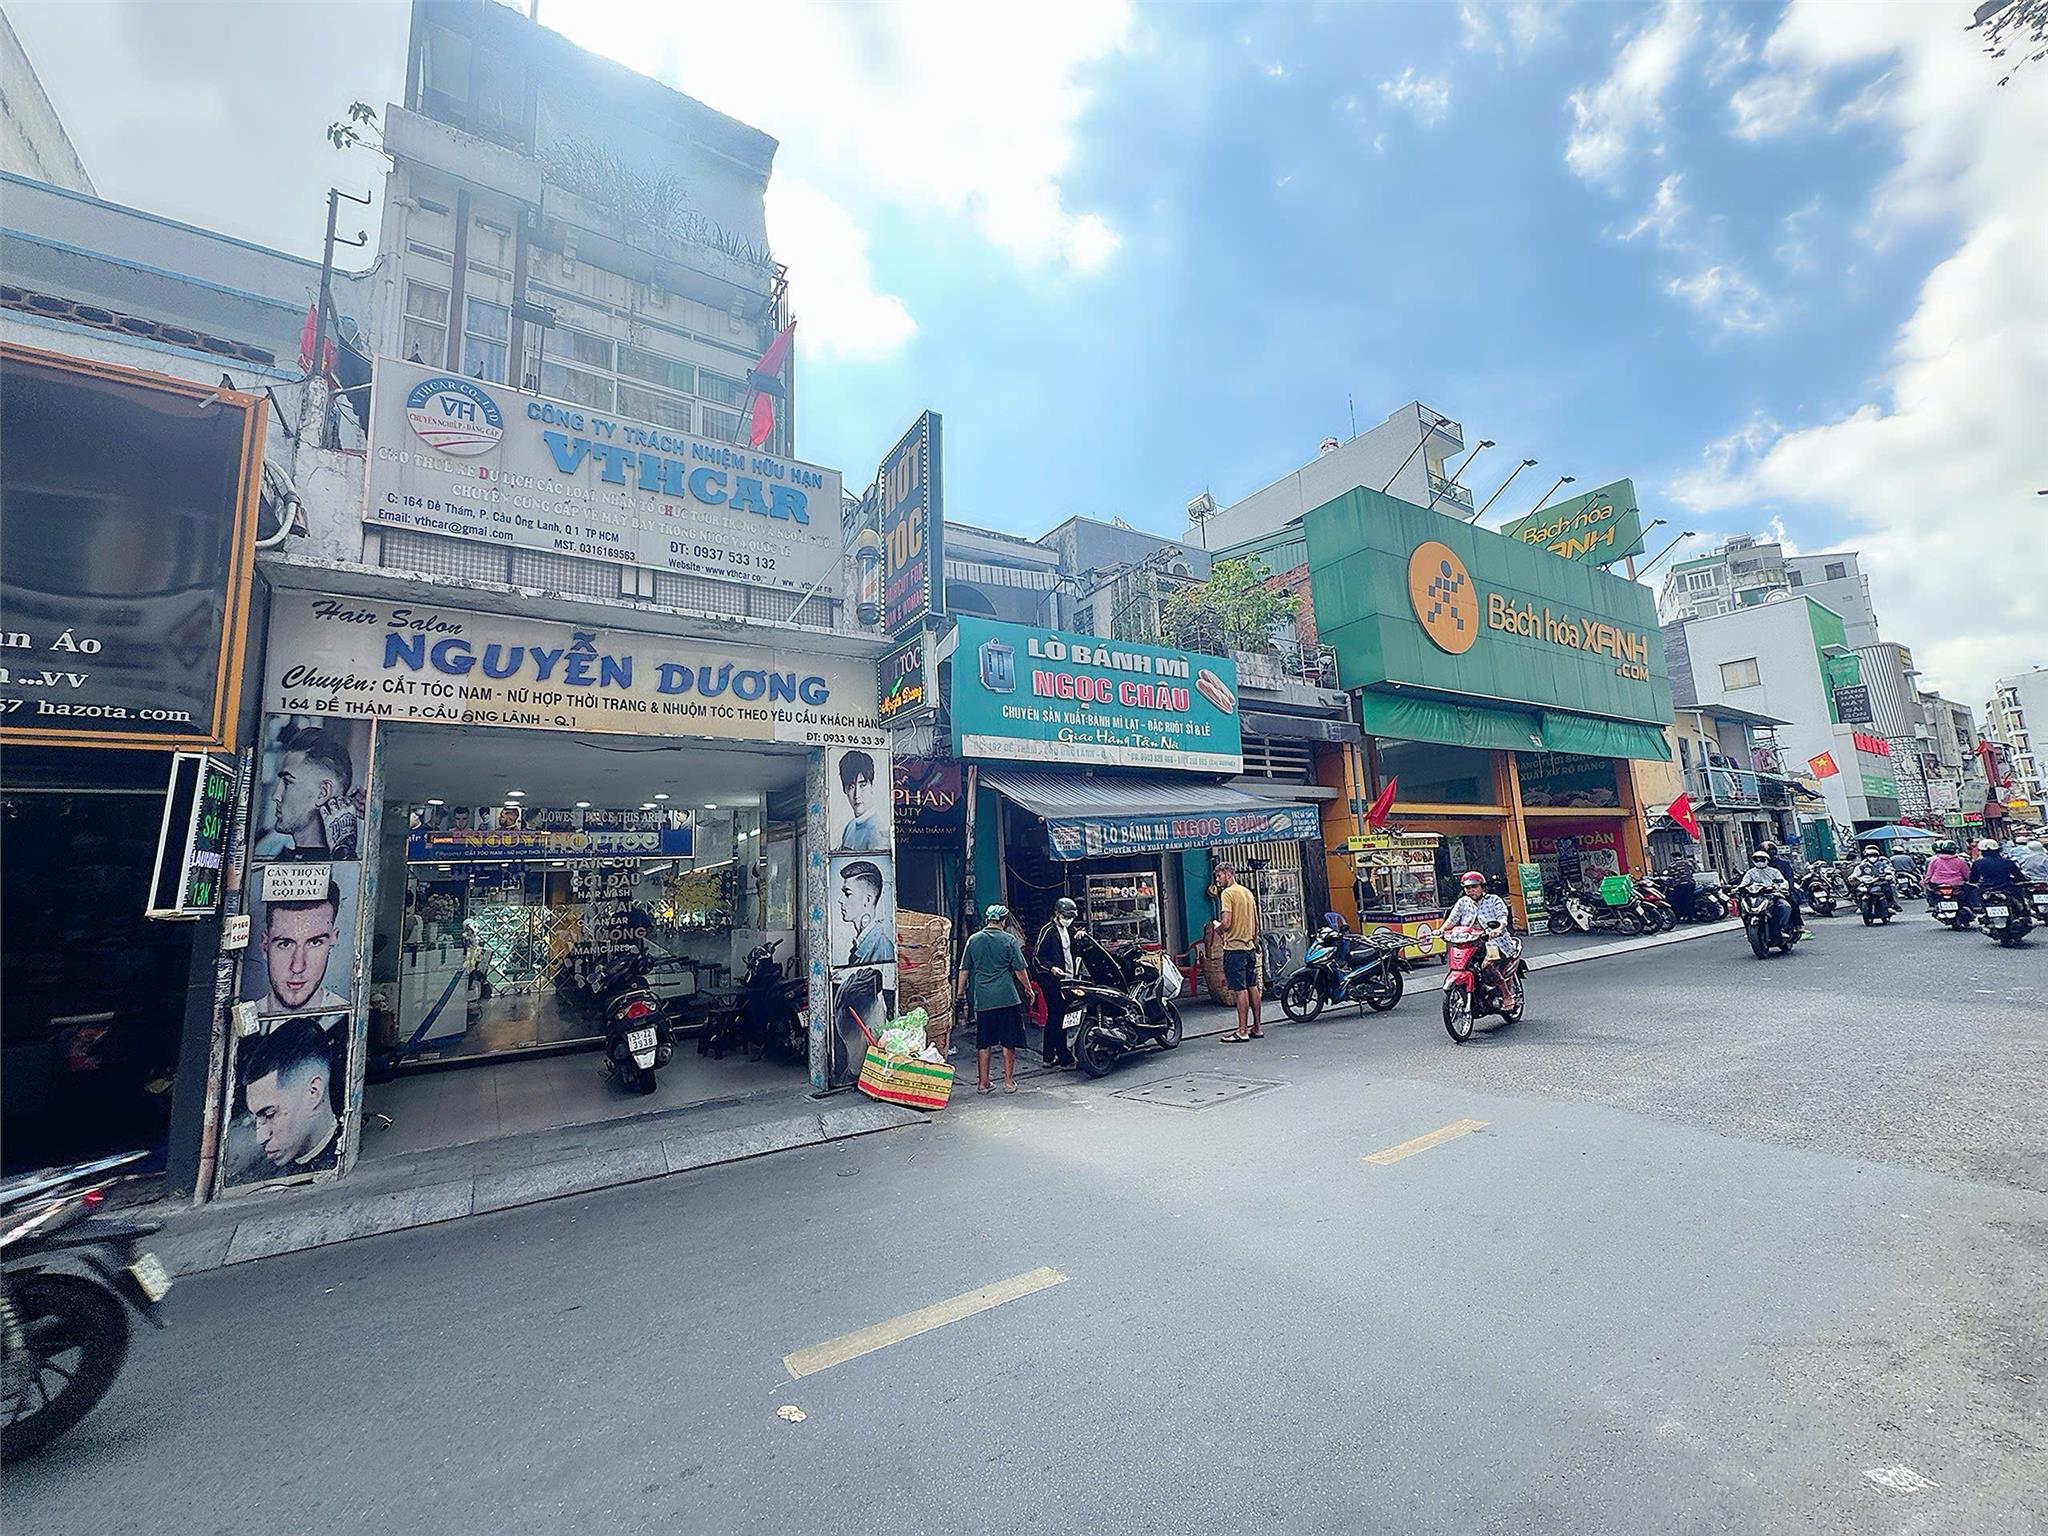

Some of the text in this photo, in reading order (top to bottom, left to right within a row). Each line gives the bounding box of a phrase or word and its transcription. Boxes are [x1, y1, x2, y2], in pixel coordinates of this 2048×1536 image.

[412, 380, 499, 422] VTHCAR LTD
[527, 402, 824, 490] CÔNG TY TRÁCH NHIỆM HỮU HẠN
[479, 467, 500, 482] DU
[537, 478, 563, 495] CÁC
[691, 511, 719, 526] TOUR
[543, 430, 810, 525] VTHCAR
[886, 438, 922, 520] HỚT
[378, 508, 411, 524] Email:
[403, 495, 423, 508] 164
[479, 509, 489, 520] P.
[586, 528, 597, 539] TP
[599, 530, 619, 543] HCM
[632, 517, 656, 531] BAY
[659, 522, 697, 539] TRONG
[1523, 504, 1614, 545] Bách hóa
[670, 541, 776, 571] ĐT: 0937 533 132
[886, 506, 923, 580] TÓC
[312, 600, 464, 635] Hair Salon
[1488, 592, 1648, 666] Bách hóa XANH
[50, 627, 102, 654] Áo
[1027, 635, 1190, 679] LÒ BÁNH MÌ
[383, 630, 633, 690] NGUYỄN
[656, 662, 831, 706] DƯƠNG
[36, 700, 192, 723] hazota.com
[280, 697, 310, 711] 164
[315, 694, 340, 712] ĐỀ
[345, 697, 392, 715] THÁM
[409, 702, 459, 720] P.CẦU
[502, 710, 541, 726] LÃNH
[554, 715, 577, 728] Q.1
[281, 664, 883, 730] Chuyên: CẮT TÓC NAM NỮ HỢP THỜI TRANG & NHUỘM TÓC THEO YÊU CẦU KHÁCH HÀN
[1032, 670, 1191, 712] NGỌC CHÂU
[806, 733, 885, 746] ĐT: 0933 96 33 39
[1058, 727, 1130, 747] Giao Hàng
[1103, 823, 1118, 844] LÒ
[1121, 822, 1152, 843] BÁNH
[1154, 820, 1169, 840] MÌ
[1171, 817, 1222, 841] NGỌC
[1224, 812, 1269, 834] CHÂU
